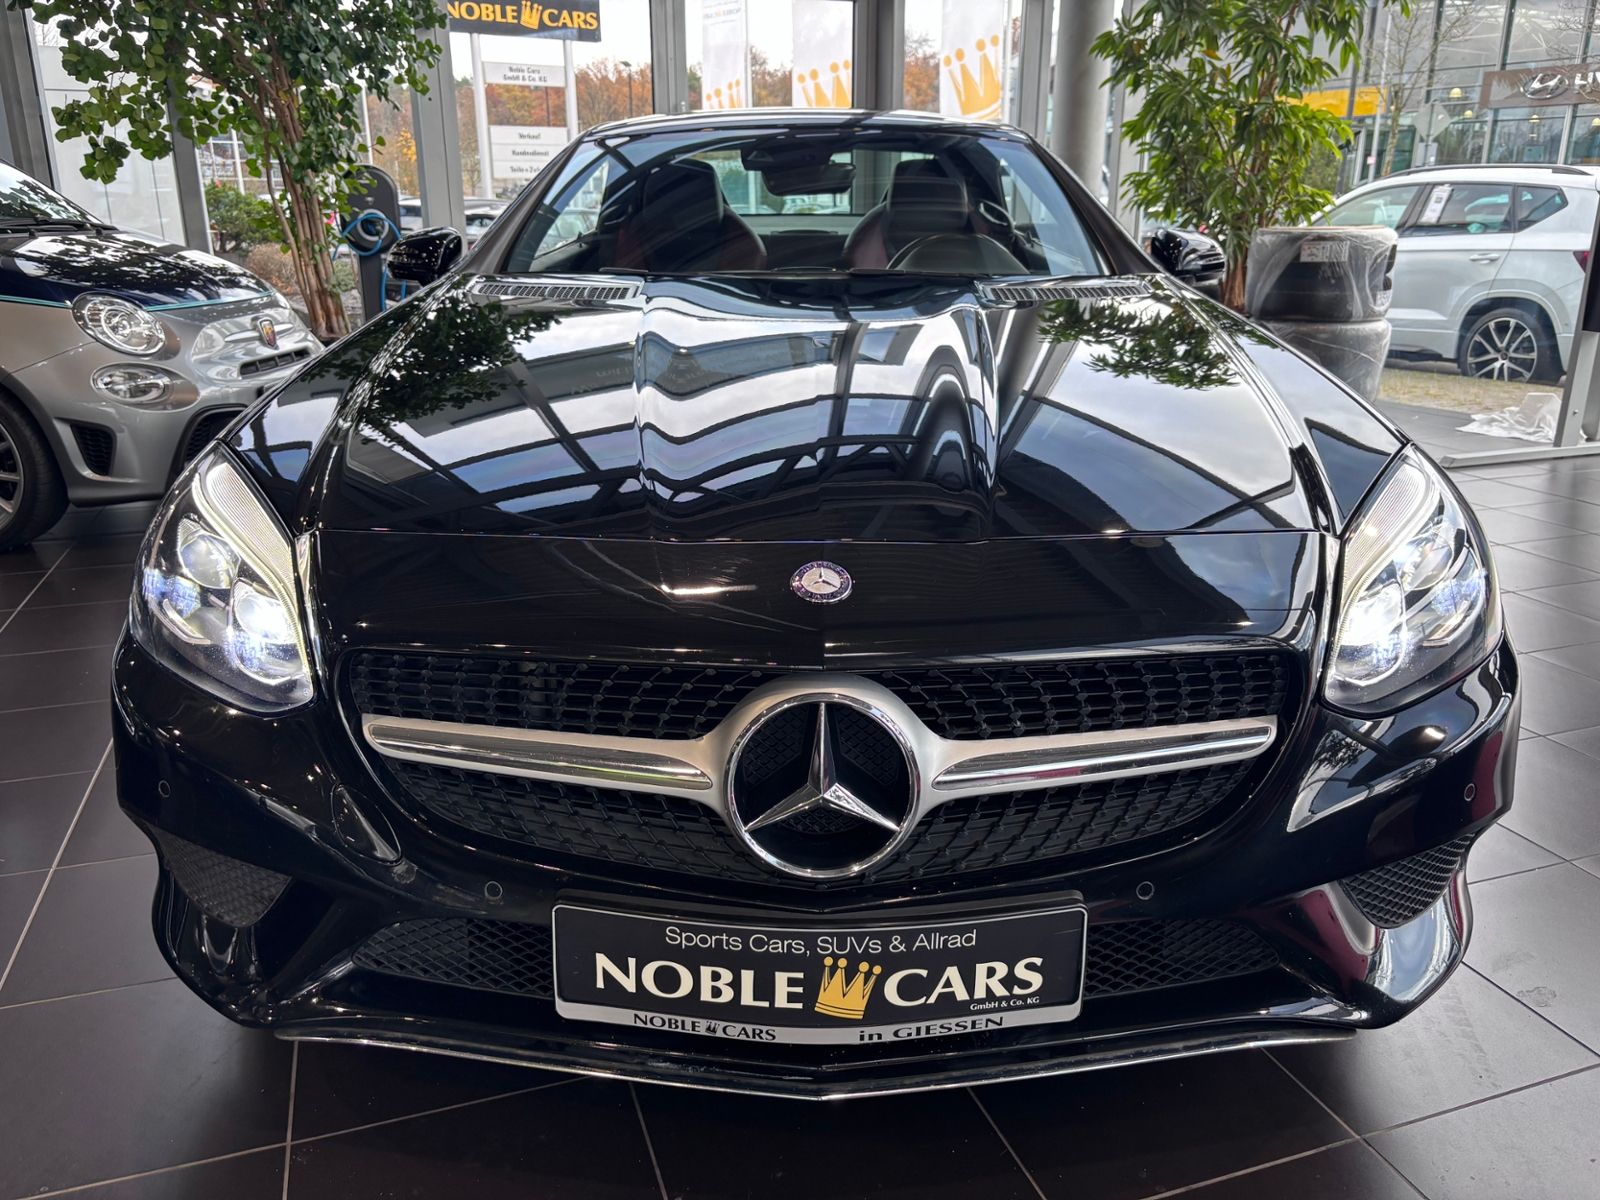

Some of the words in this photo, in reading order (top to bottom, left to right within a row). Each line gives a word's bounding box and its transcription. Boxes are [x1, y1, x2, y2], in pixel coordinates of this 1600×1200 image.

[447, 1, 518, 24] NOBLE
[542, 8, 598, 30] CARS
[665, 925, 743, 951] Sports
[750, 933, 811, 957] Cars,
[817, 935, 882, 955] SUVs
[888, 934, 907, 952] &
[912, 928, 977, 950] Allrad
[595, 952, 805, 1010] NOBLE
[883, 956, 1043, 1008] CARS
[970, 1001, 999, 1011] GmbH
[1001, 1000, 1008, 1008] &
[1010, 998, 1024, 1008] Co.
[1027, 995, 1040, 1005] KG
[634, 1013, 701, 1033] NOBLE
[722, 1023, 776, 1042] CARS
[859, 1029, 883, 1043] in
[893, 1016, 1003, 1039] GIESSEN
